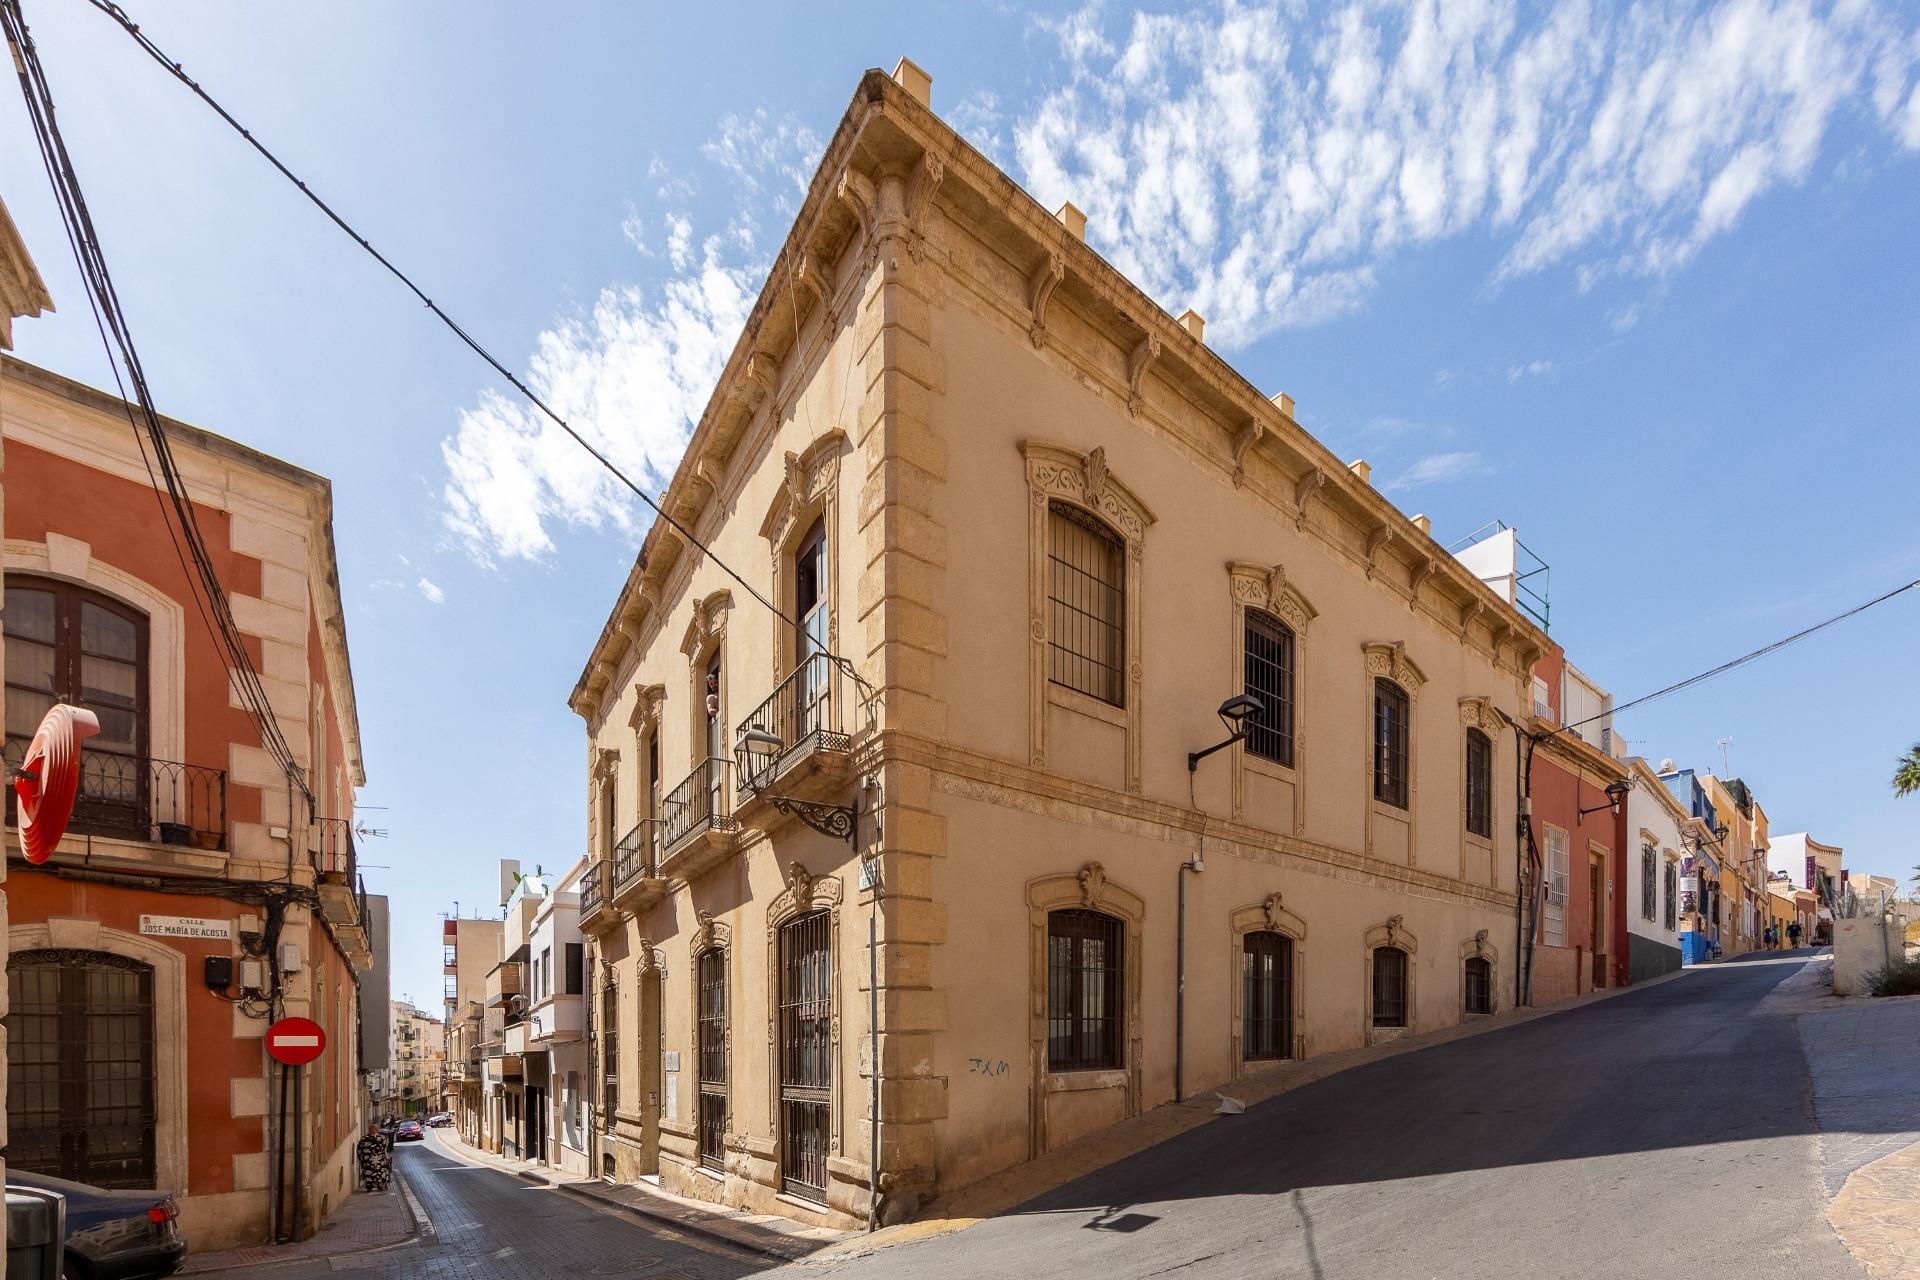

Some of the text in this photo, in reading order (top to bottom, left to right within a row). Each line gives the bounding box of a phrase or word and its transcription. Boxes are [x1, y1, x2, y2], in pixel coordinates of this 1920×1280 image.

[179, 918, 205, 926] CALLE
[143, 925, 229, 938] JOSÉ MARÍA DE ACOSTA
